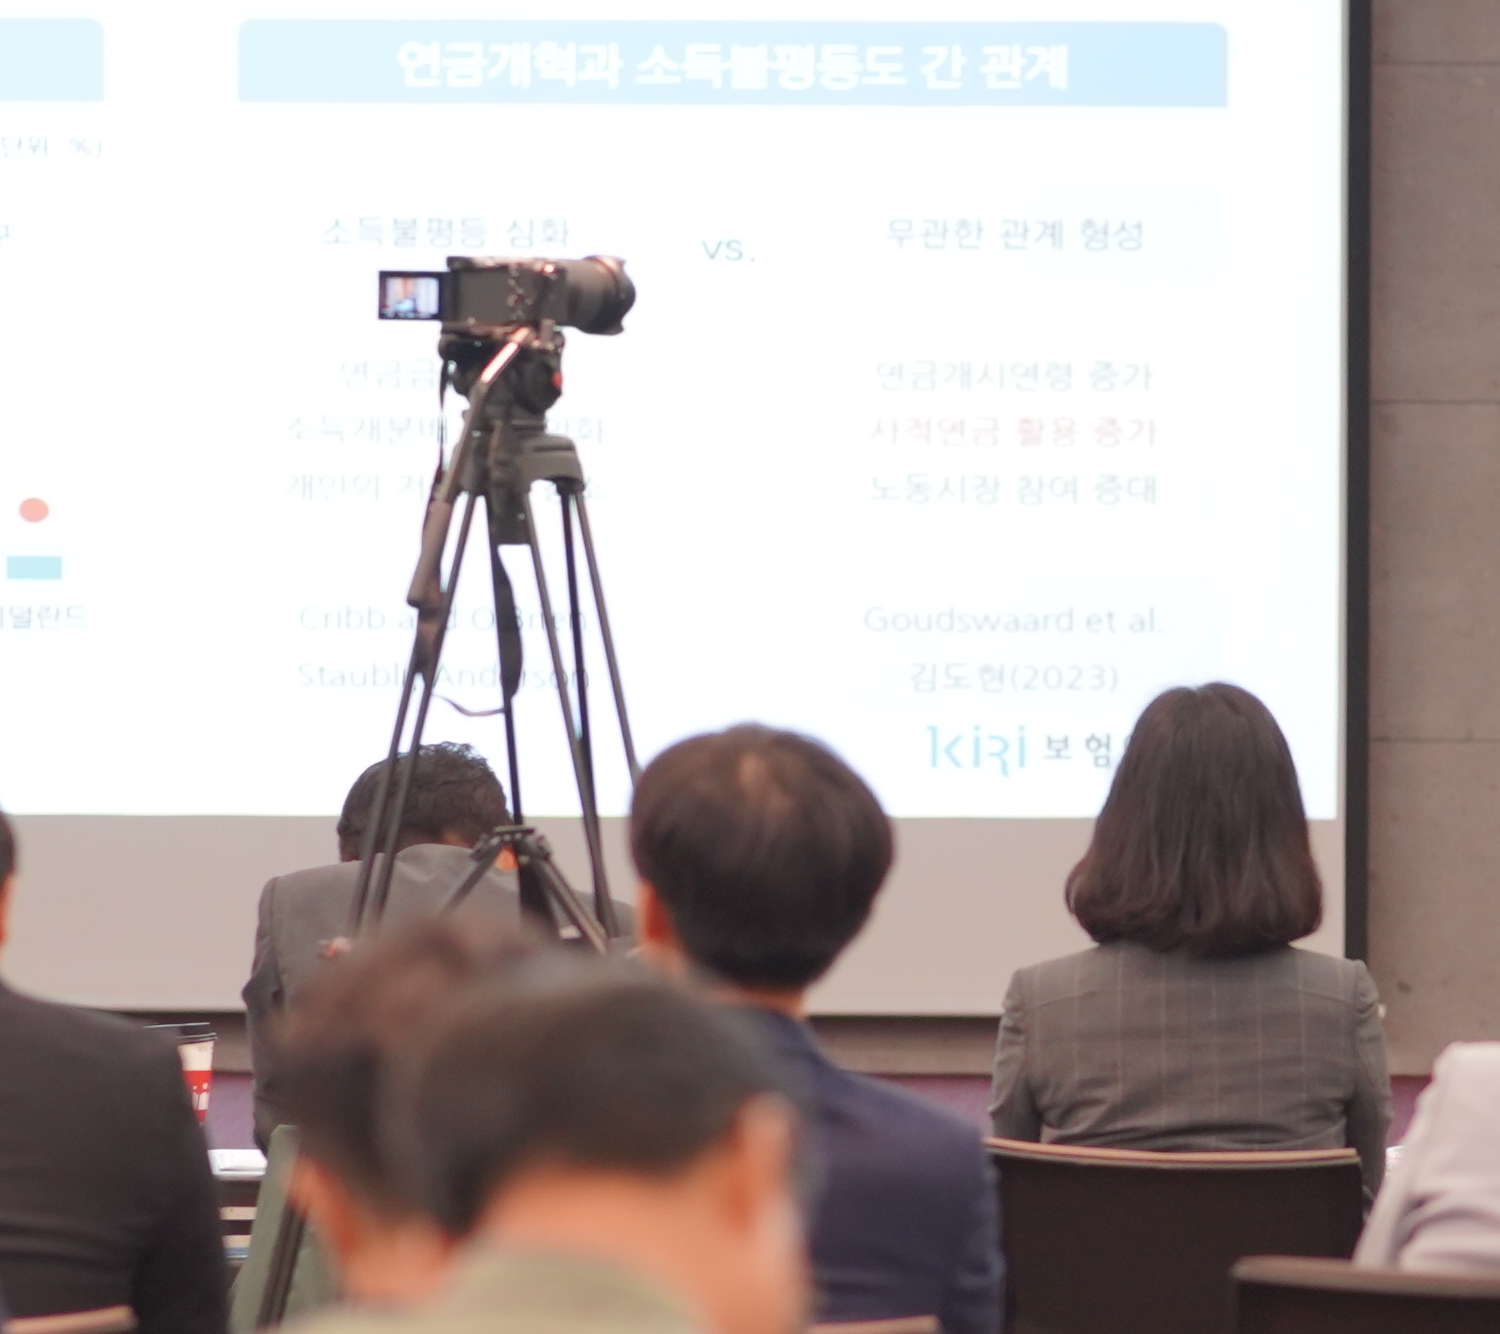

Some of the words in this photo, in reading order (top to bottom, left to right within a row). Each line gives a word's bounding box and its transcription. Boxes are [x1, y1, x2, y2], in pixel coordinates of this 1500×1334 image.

[396, 40, 623, 88] 연금개혁과
[634, 41, 907, 90] 소득불평등도
[920, 43, 967, 90] 간
[979, 43, 1070, 90] 관계
[505, 217, 571, 250] 심화
[887, 217, 986, 251] 무관한
[999, 218, 1066, 252] 관계
[862, 605, 1078, 635] Goudswaard
[1083, 609, 1118, 635] et
[909, 661, 1121, 695] 김도현(2023)
[1043, 733, 1113, 770] 보험
